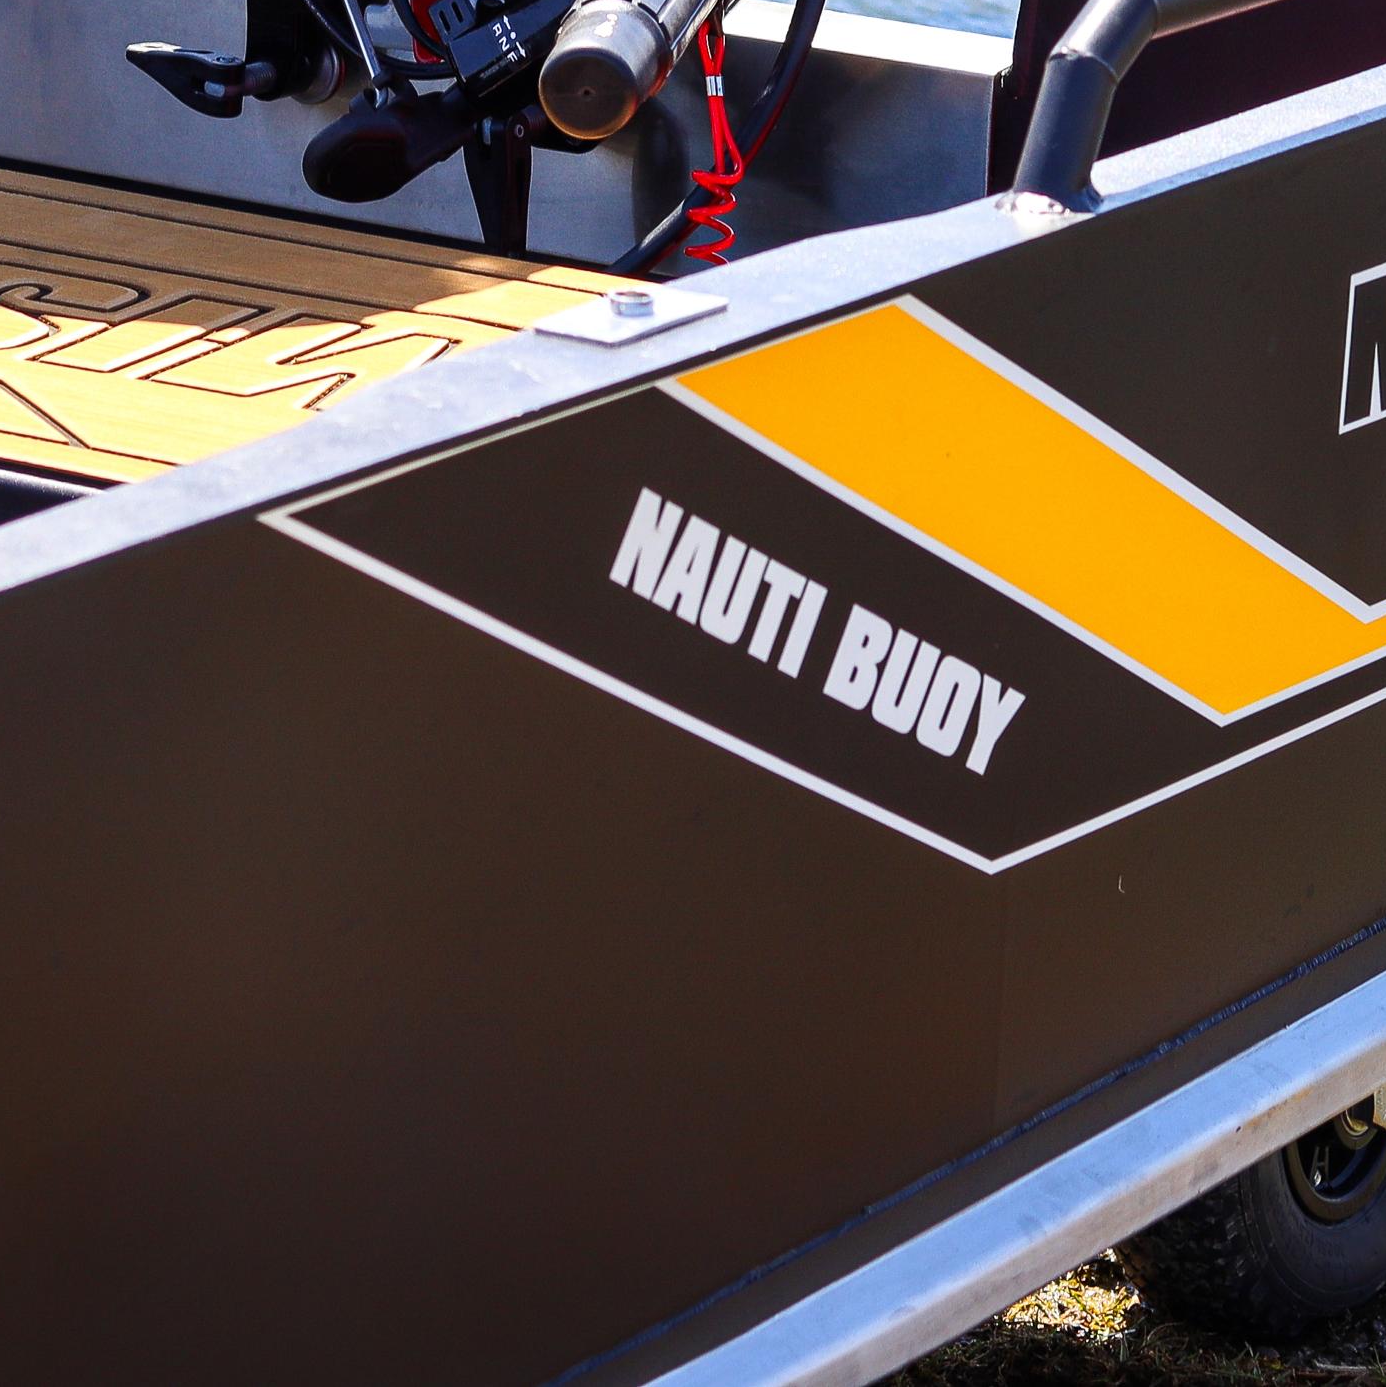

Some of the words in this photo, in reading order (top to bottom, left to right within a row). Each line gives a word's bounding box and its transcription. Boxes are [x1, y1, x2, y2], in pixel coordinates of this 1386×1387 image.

[493, 22, 503, 37] R
[499, 36, 510, 52] N
[507, 51, 518, 62] F
[608, 486, 829, 679] NAUTI
[822, 603, 1027, 776] BUOY
